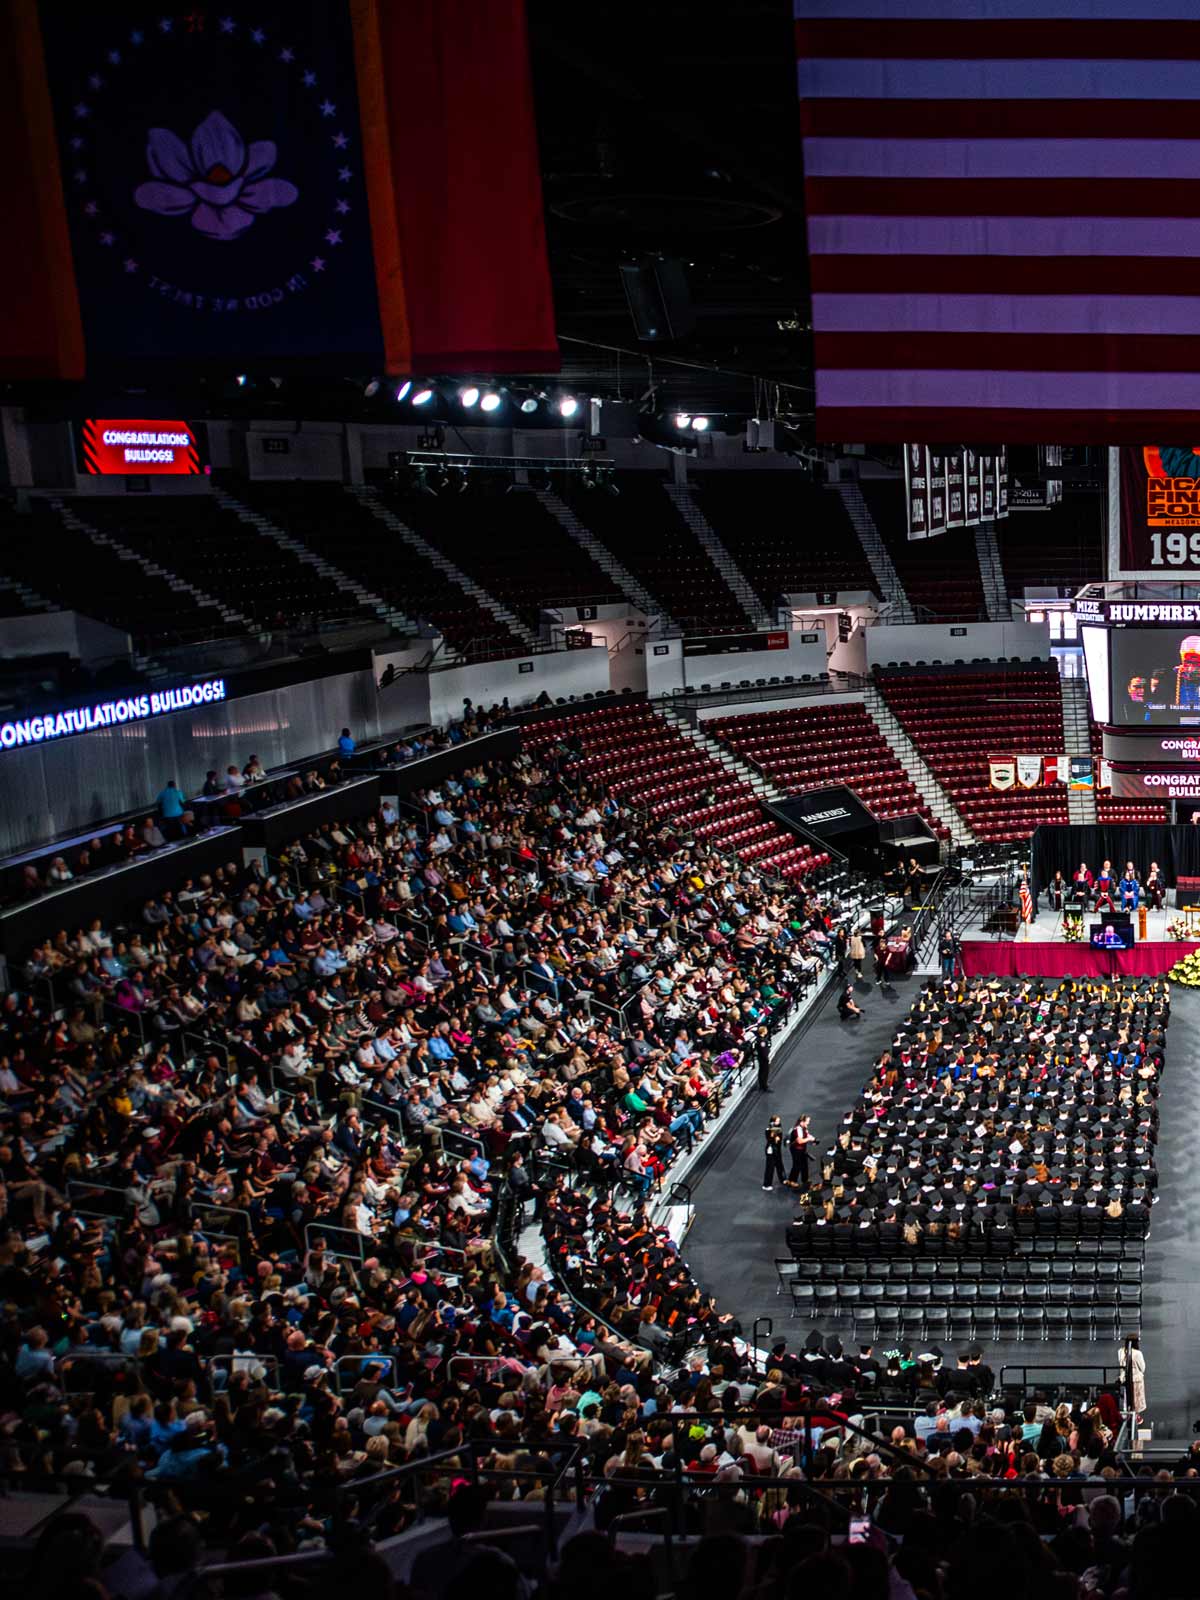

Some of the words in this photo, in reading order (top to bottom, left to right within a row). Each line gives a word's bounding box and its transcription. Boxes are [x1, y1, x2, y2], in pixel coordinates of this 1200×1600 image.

[102, 430, 189, 446] CONGRATULATIONS
[124, 448, 174, 462] BULLDOGS!
[823, 593, 831, 603] E
[584, 608, 591, 619] D
[1076, 601, 1100, 614] MIZE
[0, 696, 151, 749] ONGRATULATIONS
[151, 680, 226, 714] BULLDOGS!
